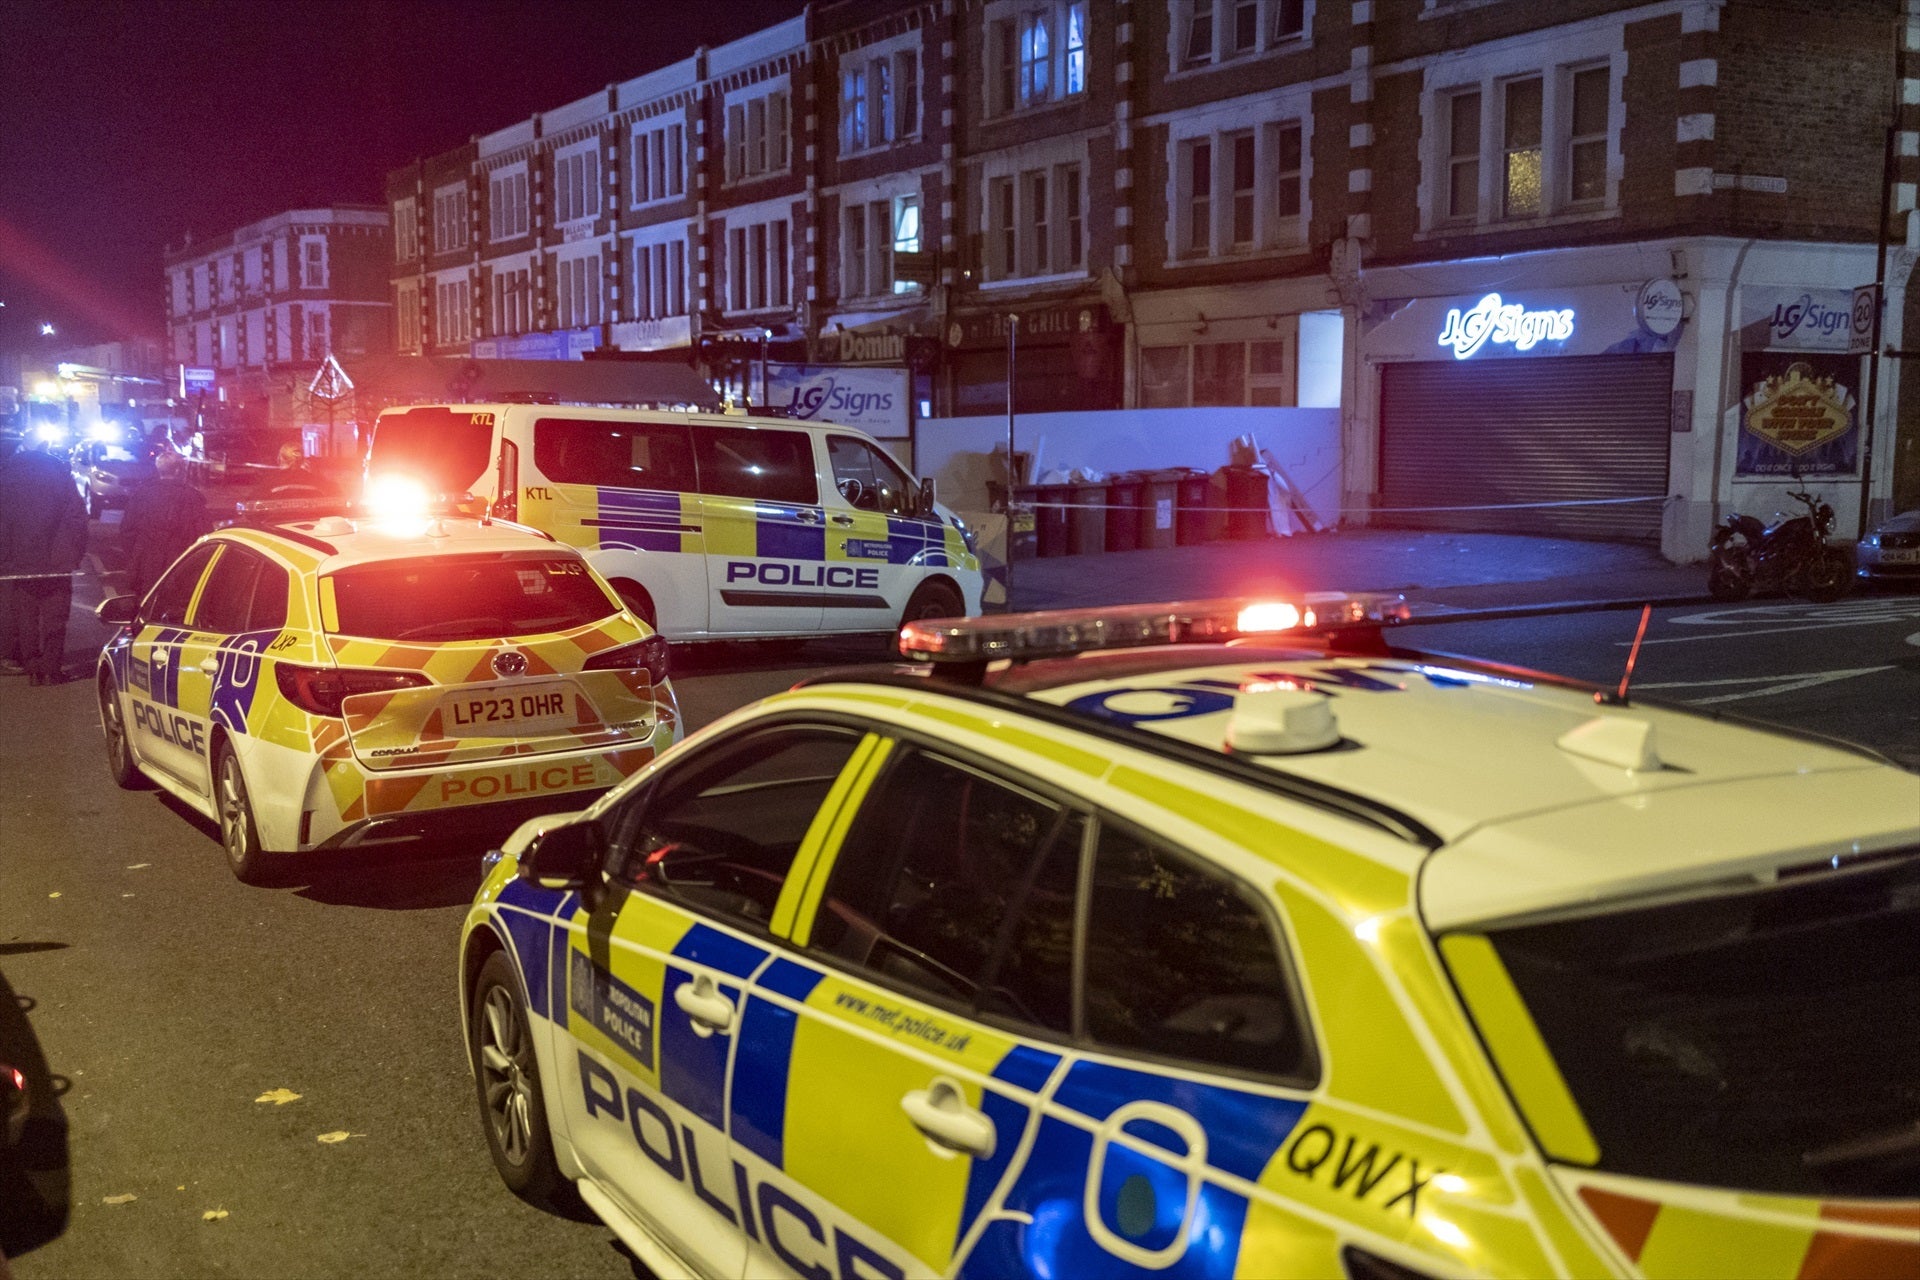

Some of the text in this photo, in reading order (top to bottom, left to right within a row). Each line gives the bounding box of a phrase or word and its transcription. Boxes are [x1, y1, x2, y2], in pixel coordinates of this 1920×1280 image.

[1028, 311, 1071, 334] GRILL
[1805, 304, 1852, 335] Sign
[1857, 304, 1870, 322] 20
[840, 327, 904, 360] Domin
[1850, 337, 1871, 349] ZONE
[830, 386, 892, 417] Signs
[470, 413, 493, 425] KTL
[526, 487, 552, 500] KTL
[867, 549, 889, 557] POLICE
[727, 562, 879, 589] POLICE
[271, 635, 298, 651] LXP
[453, 693, 565, 725] LP23 OHR
[132, 699, 206, 757] POLICE
[441, 764, 596, 801] POLICE
[603, 1006, 642, 1050] POLICE
[835, 992, 971, 1051] www.met.police.uk
[1287, 1124, 1446, 1219] QWX
